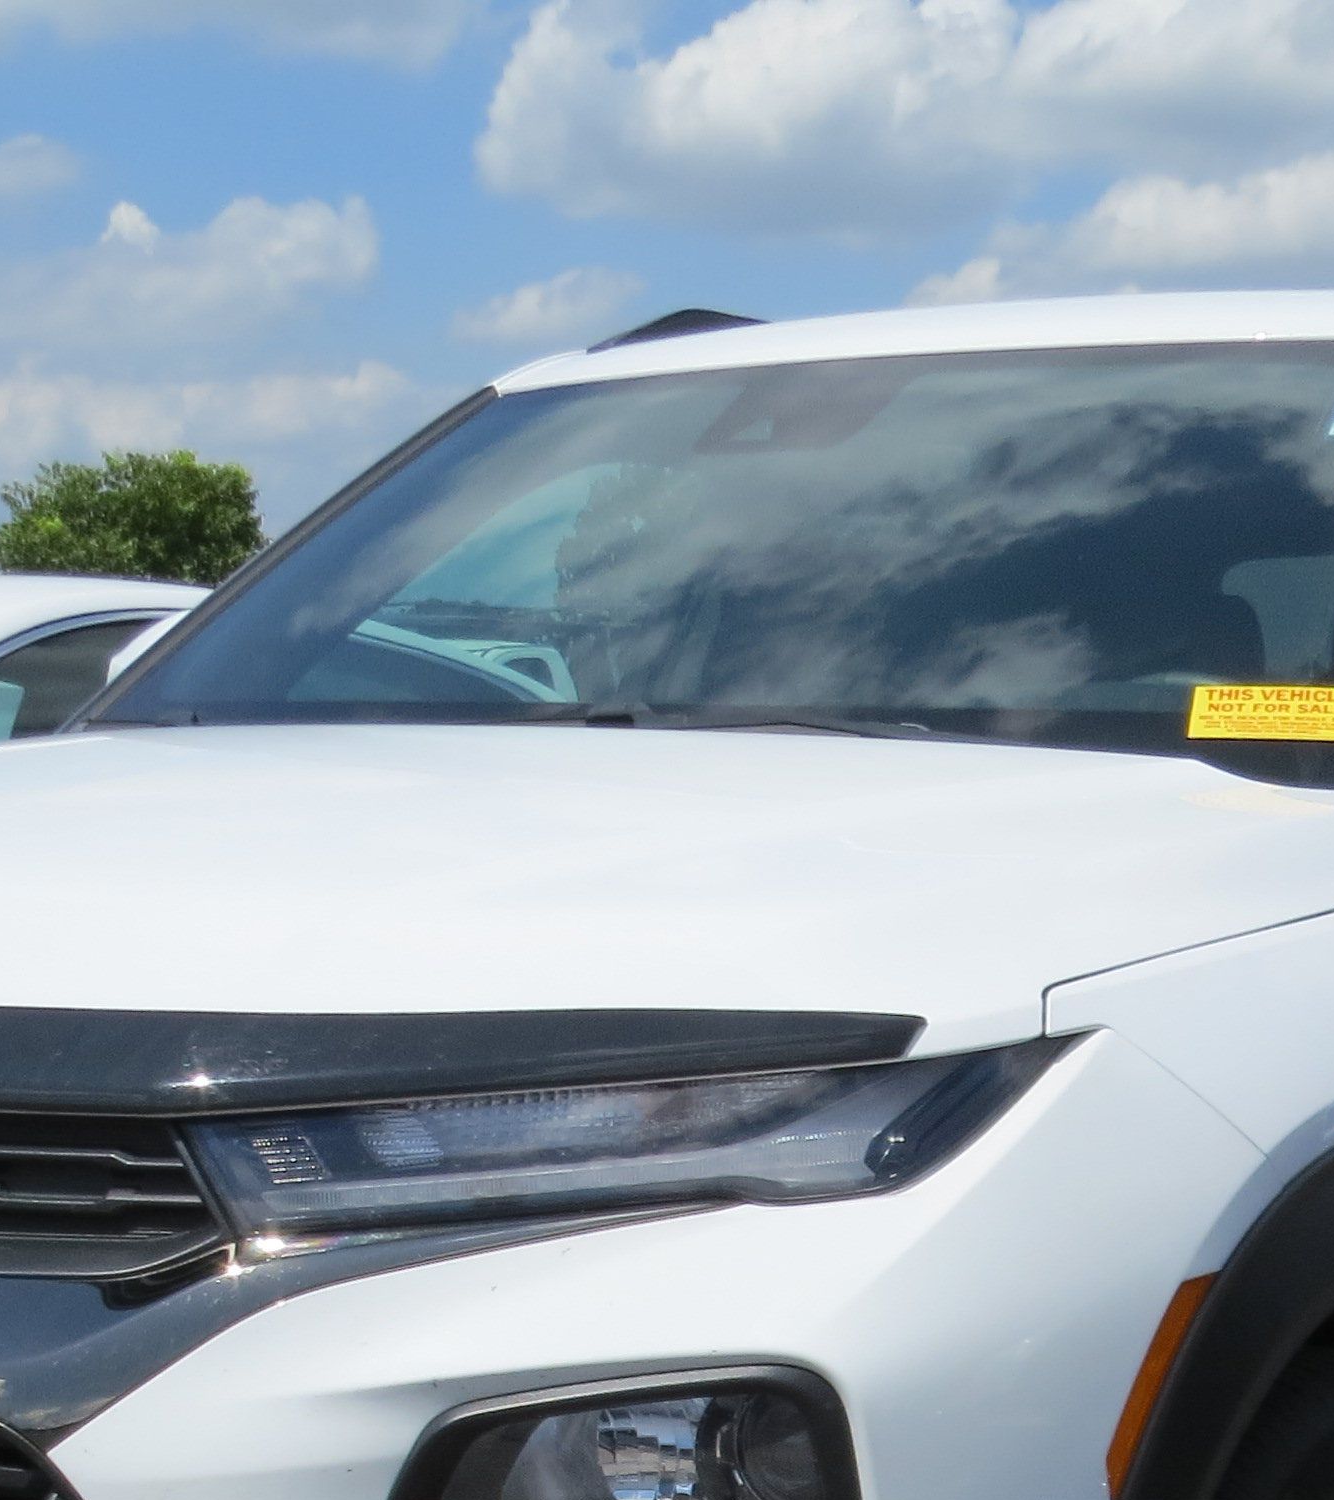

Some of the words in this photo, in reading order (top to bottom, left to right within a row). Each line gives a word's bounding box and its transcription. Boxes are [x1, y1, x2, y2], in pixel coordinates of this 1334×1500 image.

[1205, 689, 1254, 701] THIS
[1208, 703, 1246, 712] NOT
[1252, 703, 1291, 713] FOR
